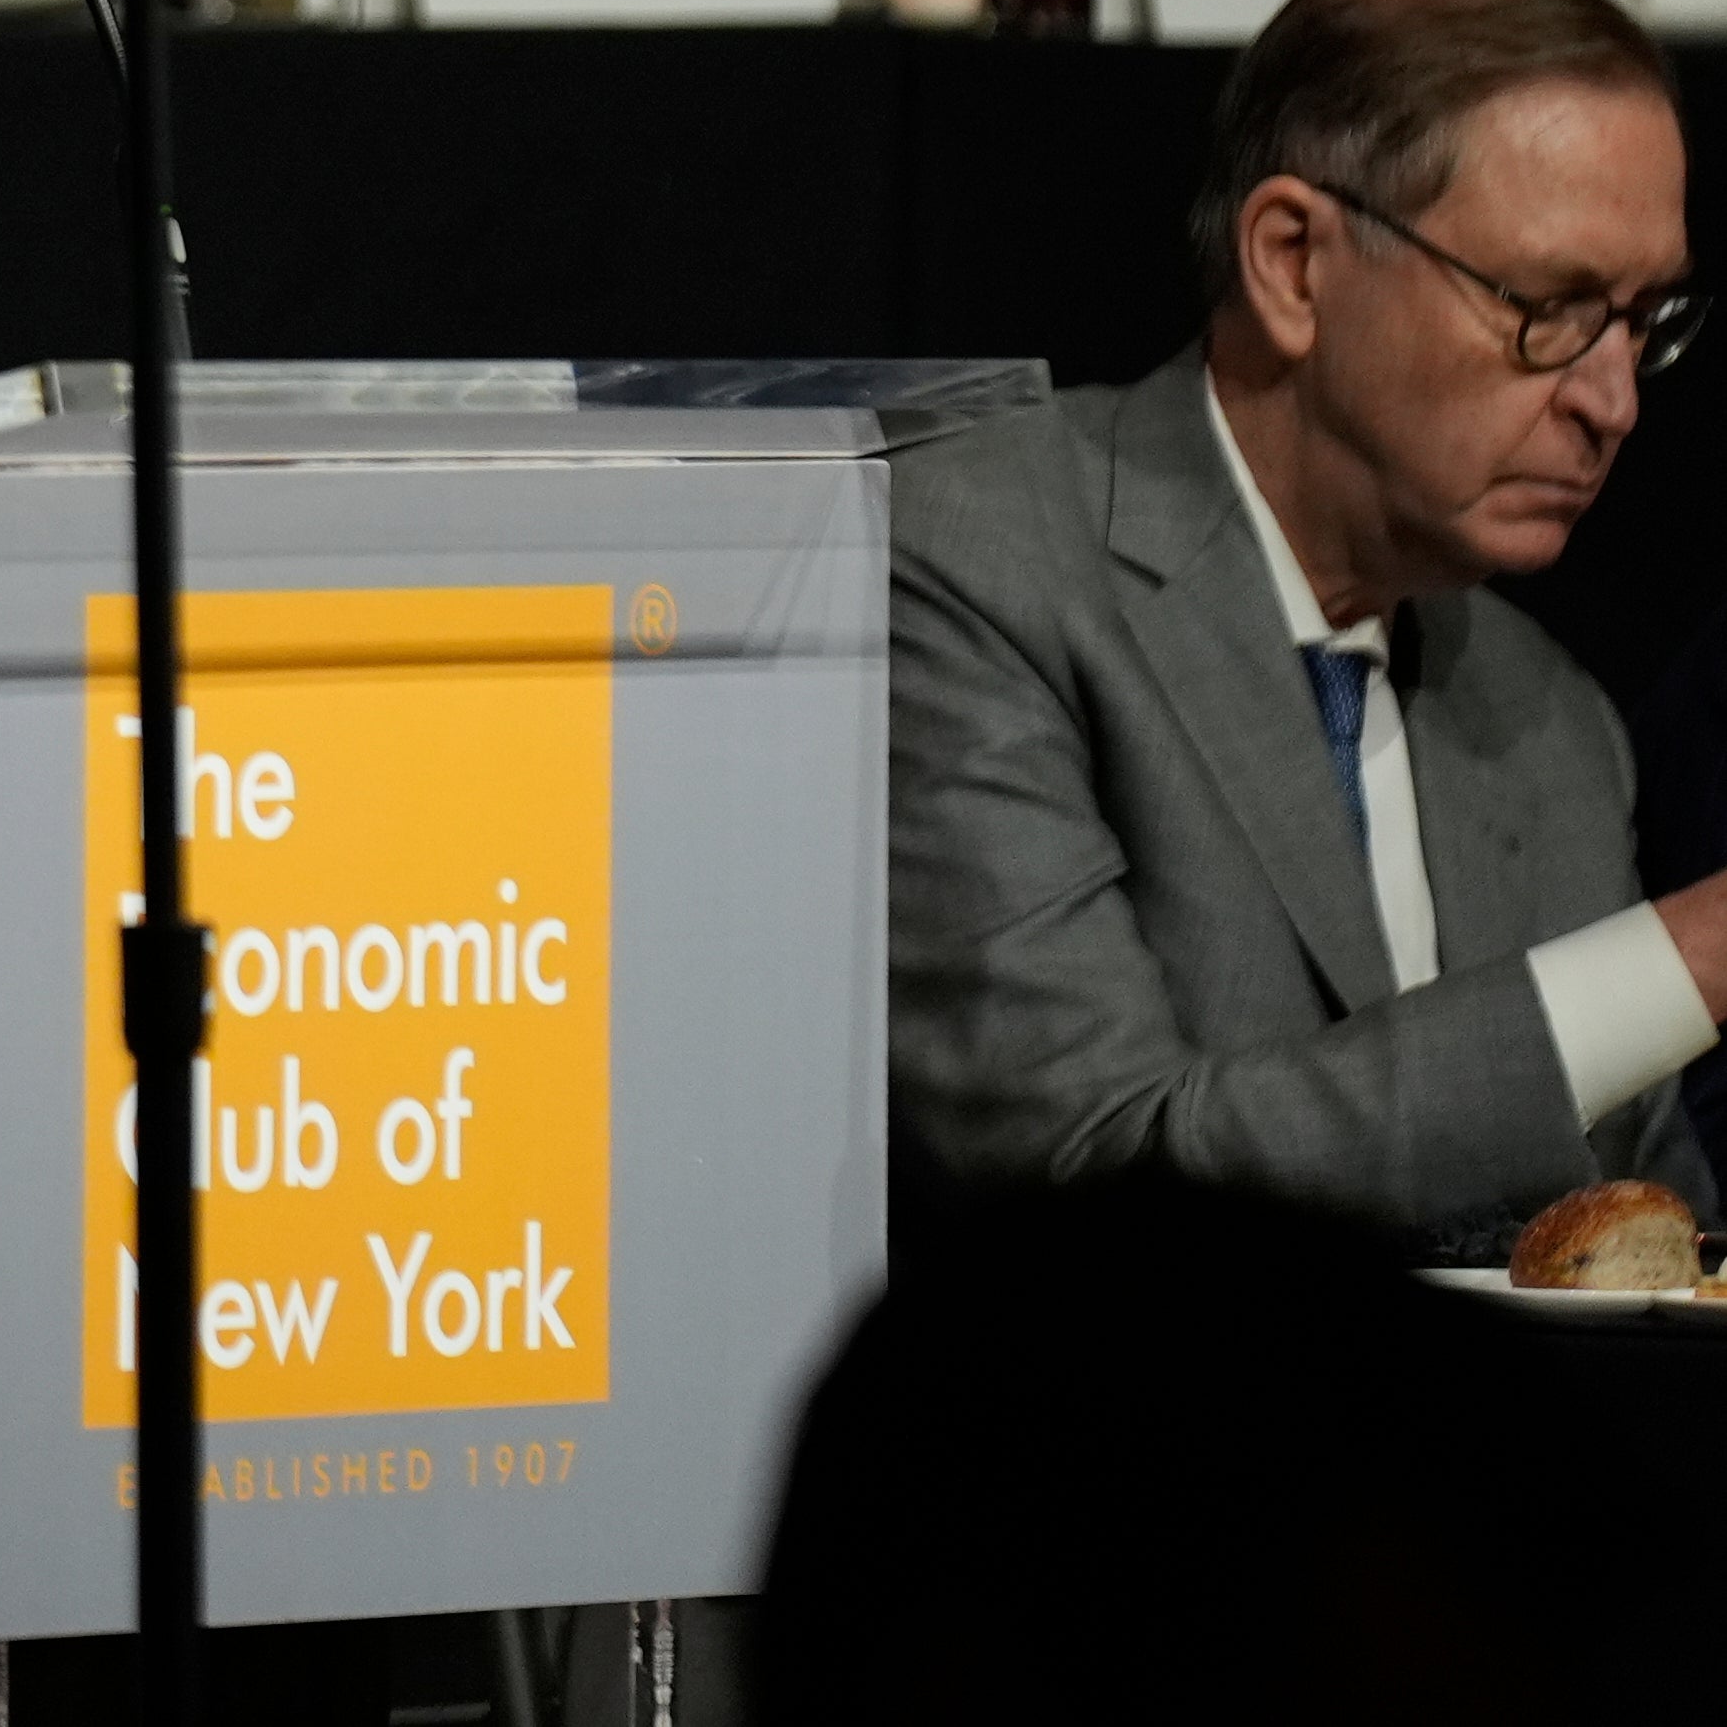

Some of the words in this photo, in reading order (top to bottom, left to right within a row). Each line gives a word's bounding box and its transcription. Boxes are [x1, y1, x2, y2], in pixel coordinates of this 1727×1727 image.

[117, 877, 568, 1019] onomic
[375, 1045, 475, 1186] of
[364, 1218, 578, 1358] York
[116, 1447, 434, 1510] EABLISHED
[465, 1439, 577, 1488] 1907
